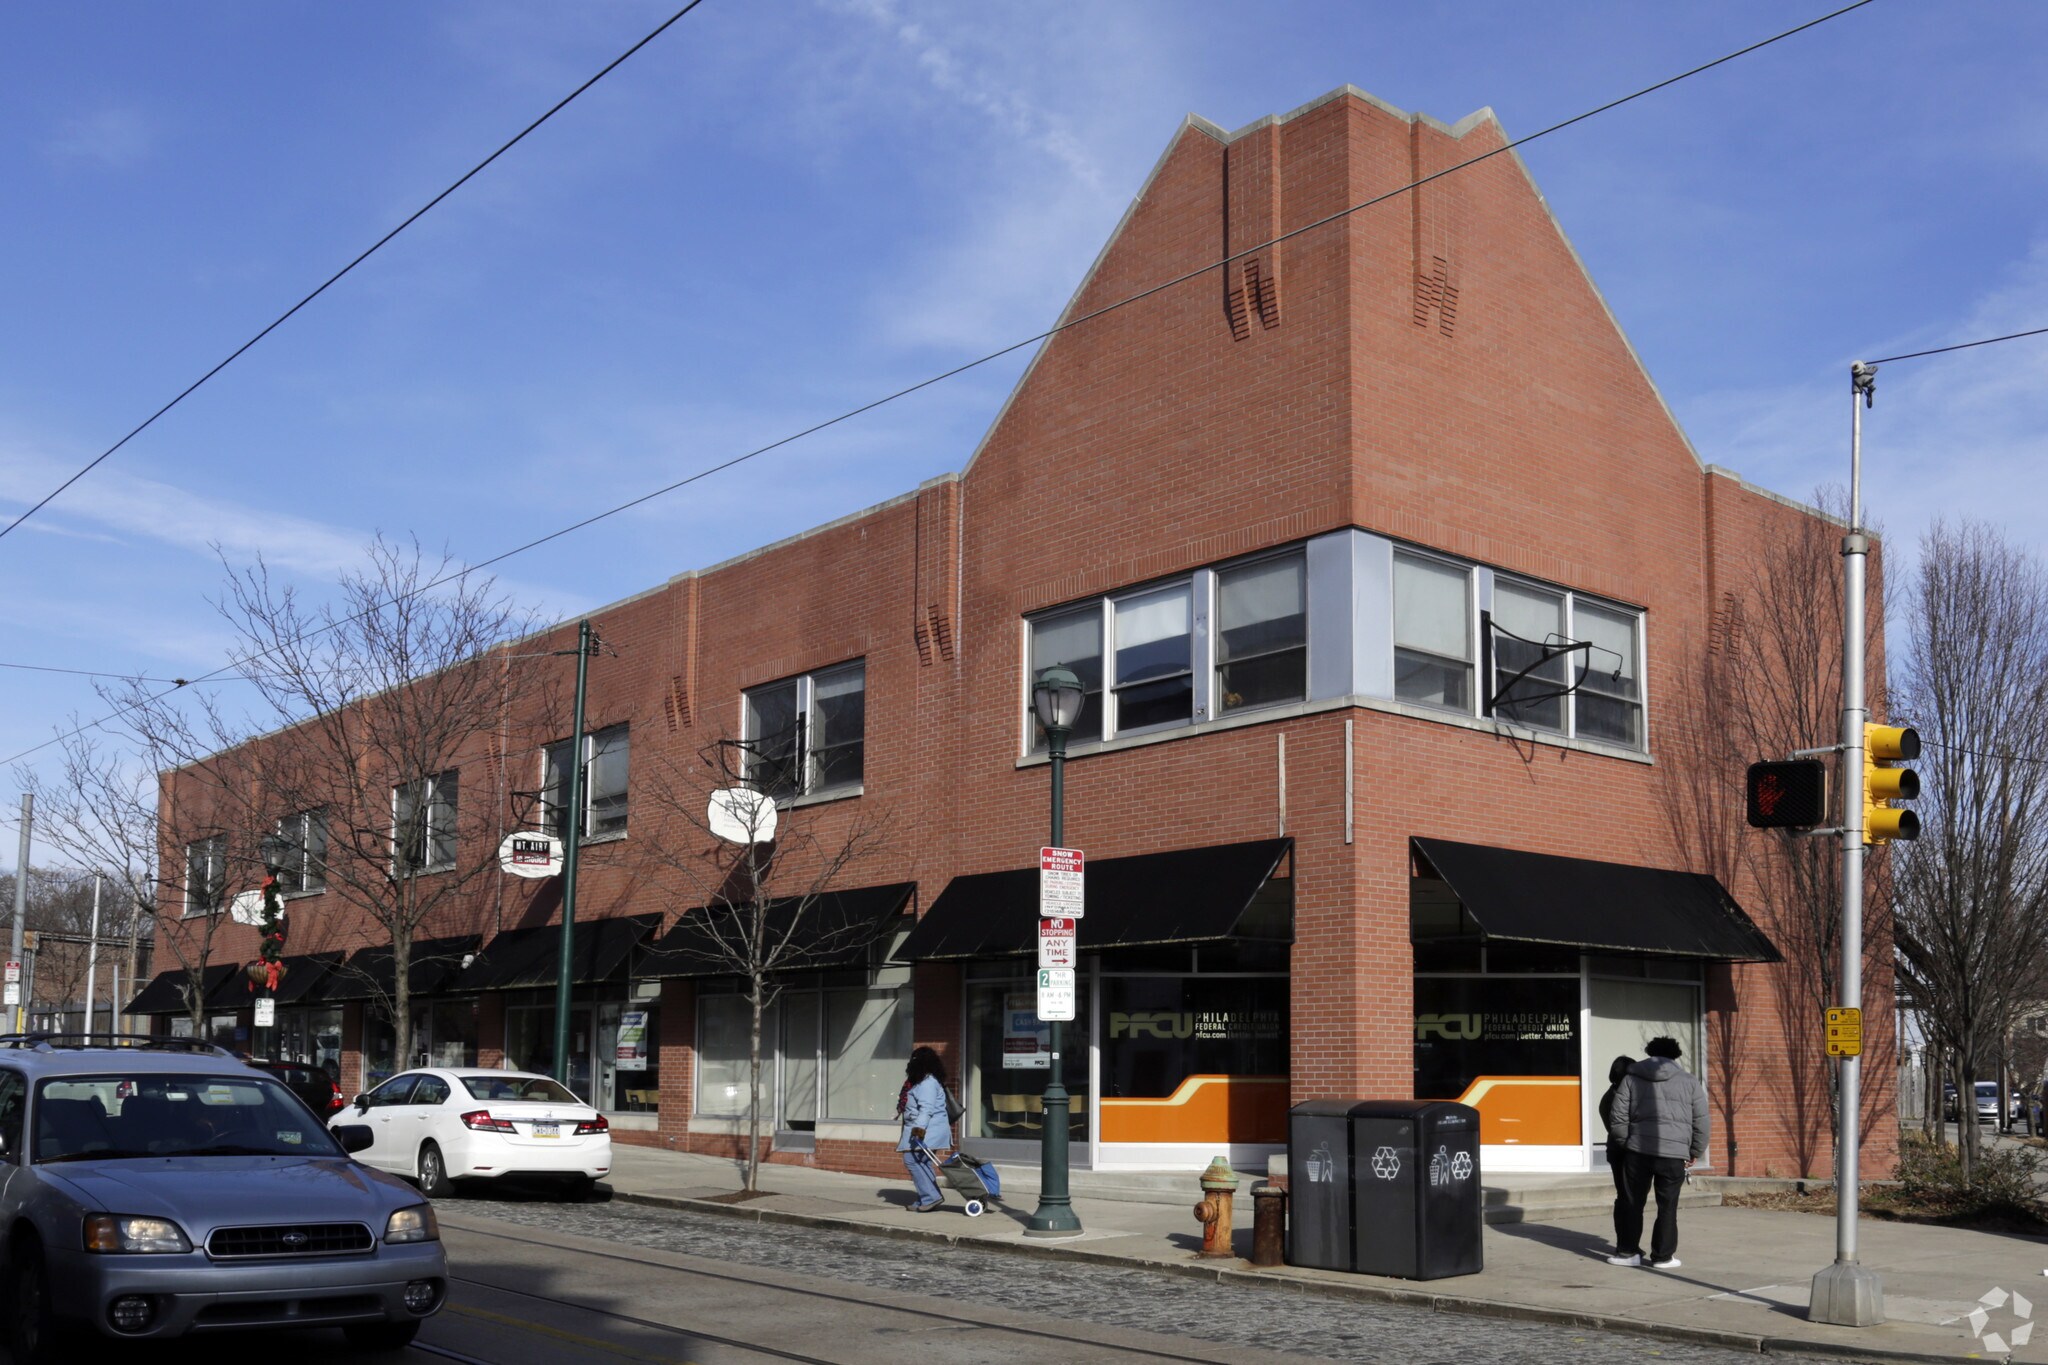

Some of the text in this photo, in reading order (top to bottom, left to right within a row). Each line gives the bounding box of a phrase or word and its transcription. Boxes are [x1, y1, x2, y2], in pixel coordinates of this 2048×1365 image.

[530, 841, 548, 851] AIRY
[1042, 856, 1082, 865] EMERGENCY
[1051, 863, 1074, 871] ROUTE
[1051, 919, 1064, 929] NO
[1042, 973, 1049, 986] 2
[1484, 1013, 1570, 1024] PHILADELPHIA
[1110, 1012, 1280, 1039] PFCU PHILADELPHIA
[1195, 1023, 1226, 1031] FEDERAL
[1484, 1024, 1515, 1032] FEDERAL
[1518, 1024, 1543, 1032] CREDIT
[1195, 1031, 1227, 1040] pfcu.com
[1520, 1032, 1543, 1040] better.
